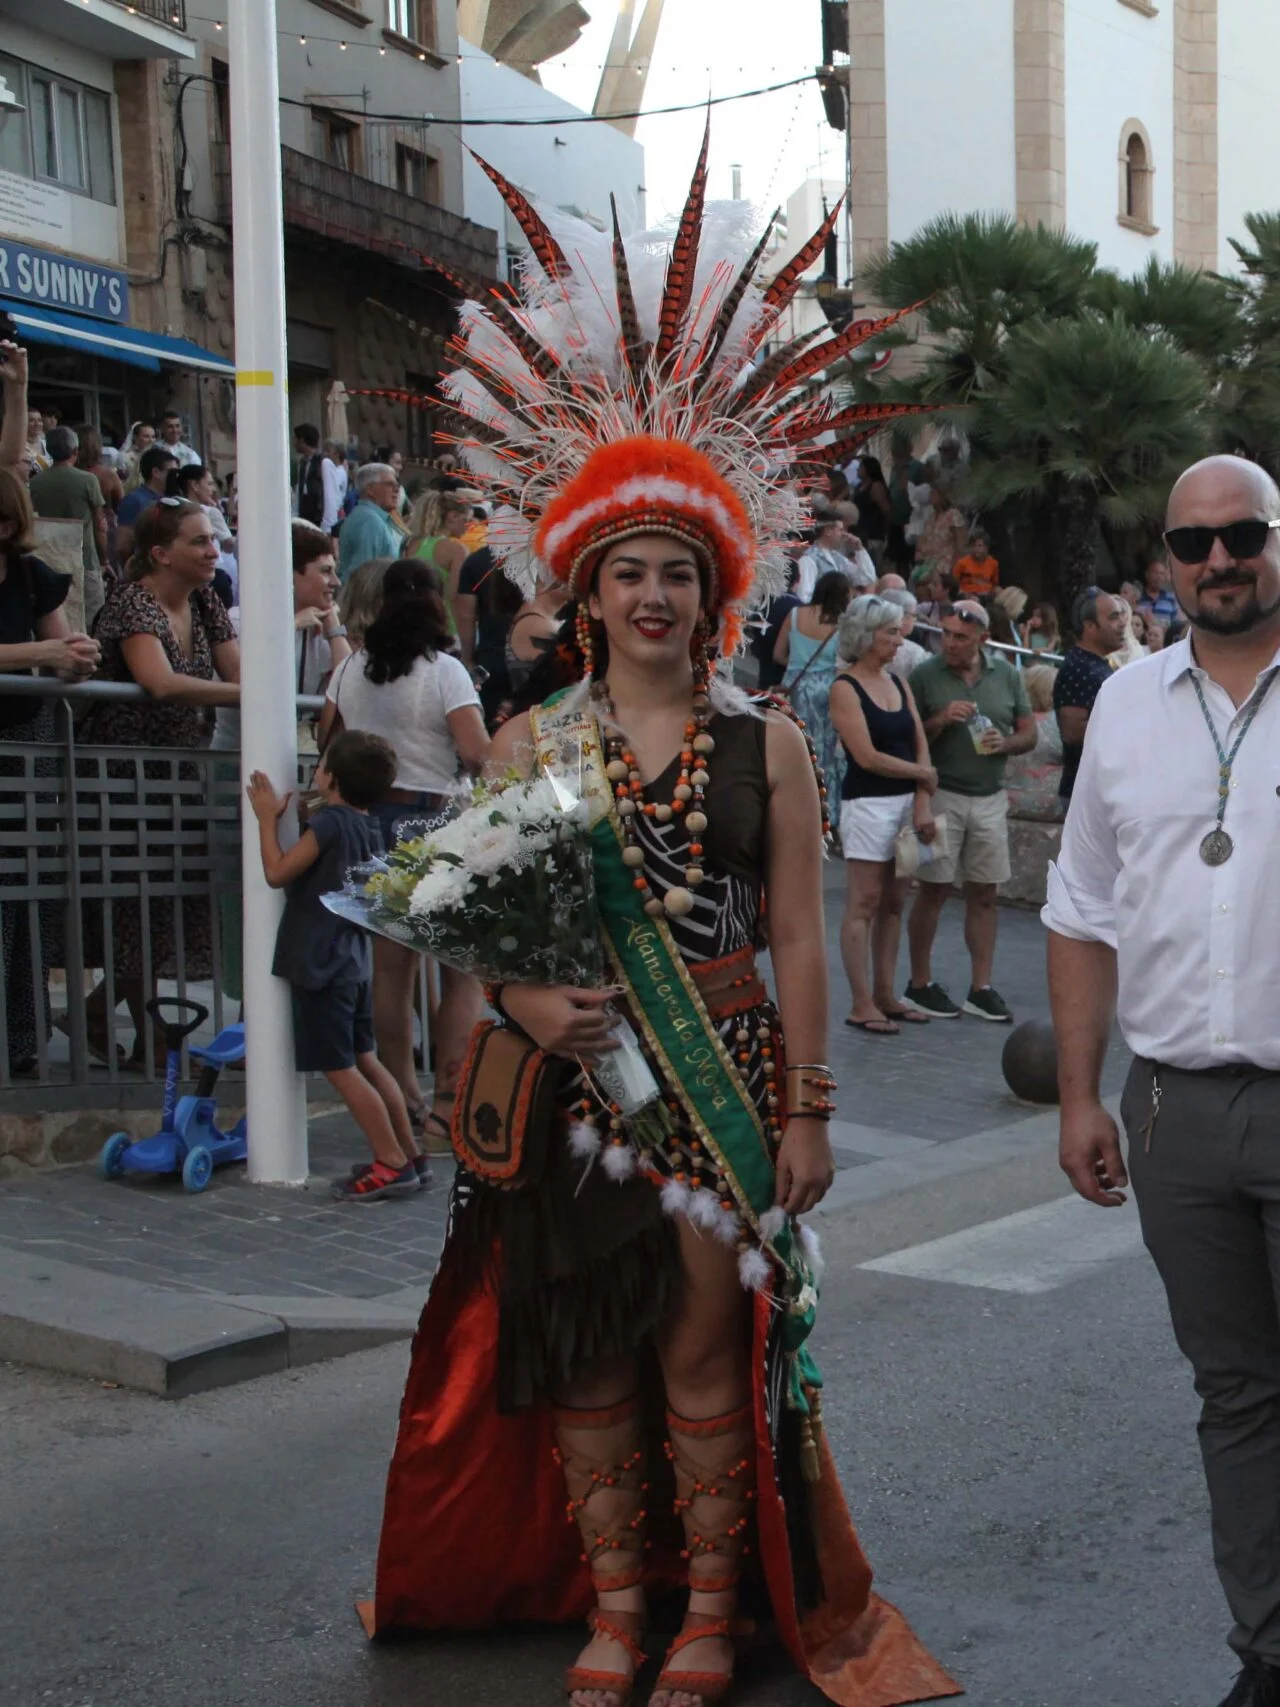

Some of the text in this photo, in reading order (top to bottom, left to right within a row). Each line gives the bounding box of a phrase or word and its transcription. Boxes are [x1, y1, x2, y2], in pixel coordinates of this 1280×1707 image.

[17, 253, 121, 315] SUNNY'S
[622, 917, 728, 1110] Abanderada Mora
